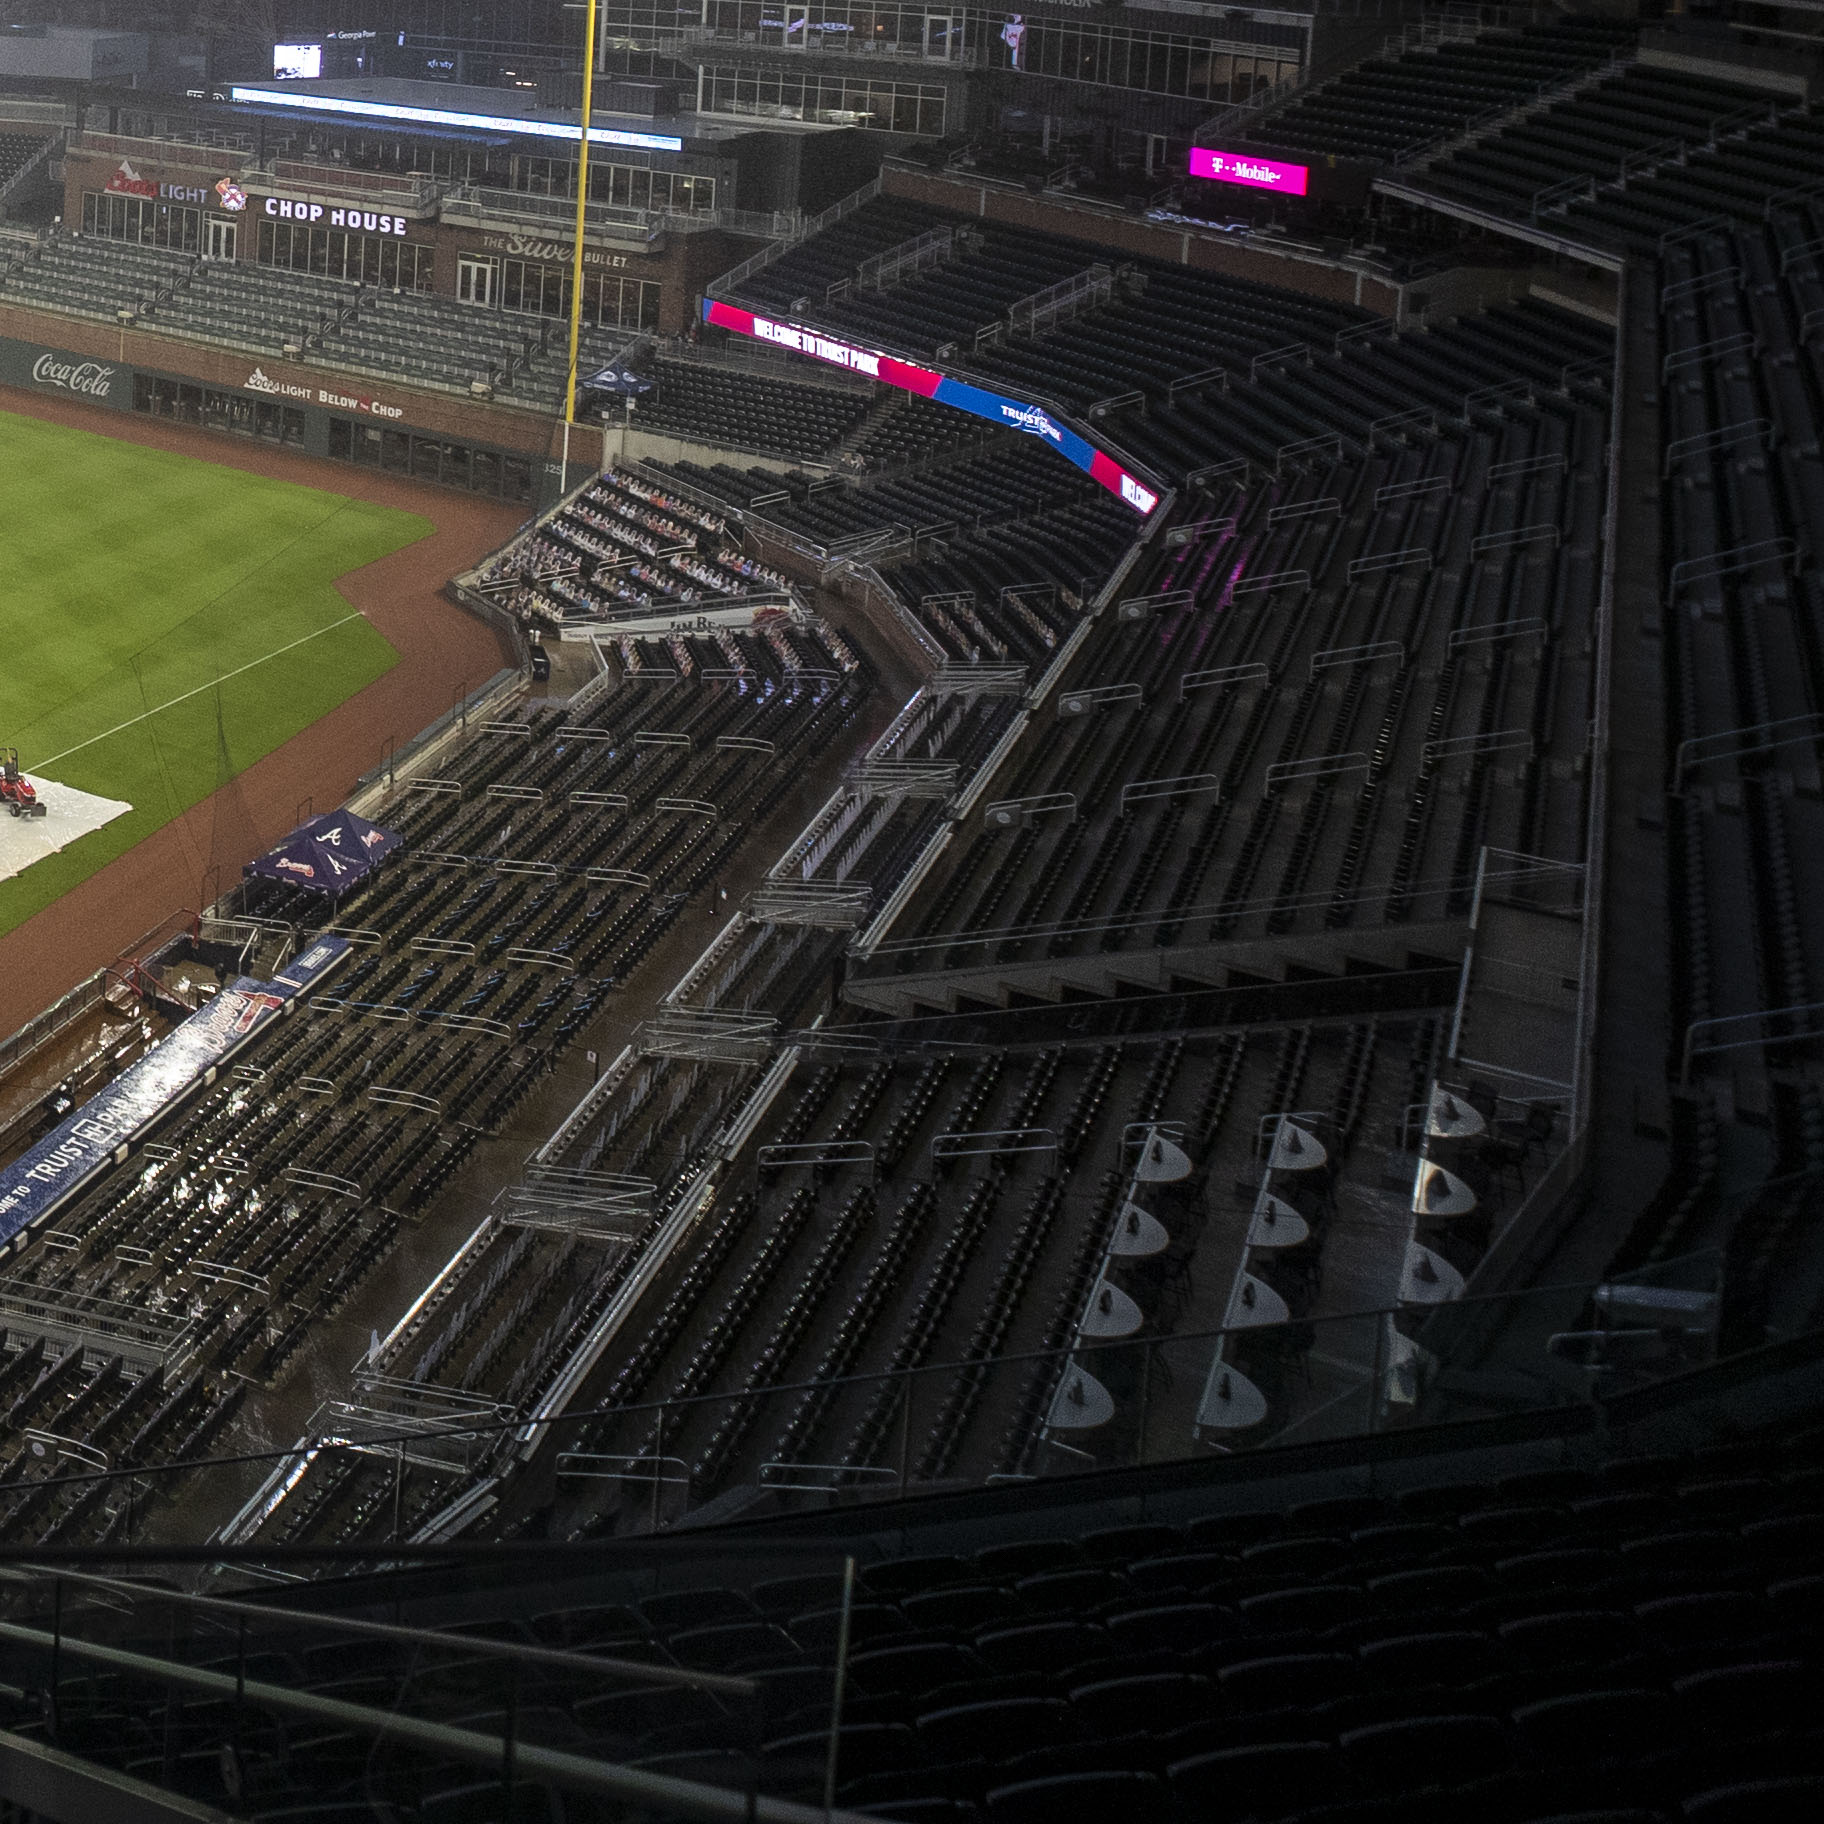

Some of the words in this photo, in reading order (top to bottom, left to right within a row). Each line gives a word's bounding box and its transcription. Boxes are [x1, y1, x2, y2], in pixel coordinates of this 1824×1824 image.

[160, 183, 208, 204] LIGHT
[265, 198, 323, 222] CHOP
[331, 210, 407, 236] HOUSE
[483, 236, 504, 249] THE
[584, 252, 628, 268] BULLET
[753, 317, 802, 350] WELCOME
[801, 333, 816, 354] TO
[281, 383, 312, 400] LIGHT
[11, 1184, 31, 1202] TO
[25, 1135, 92, 1185] TRUIST
